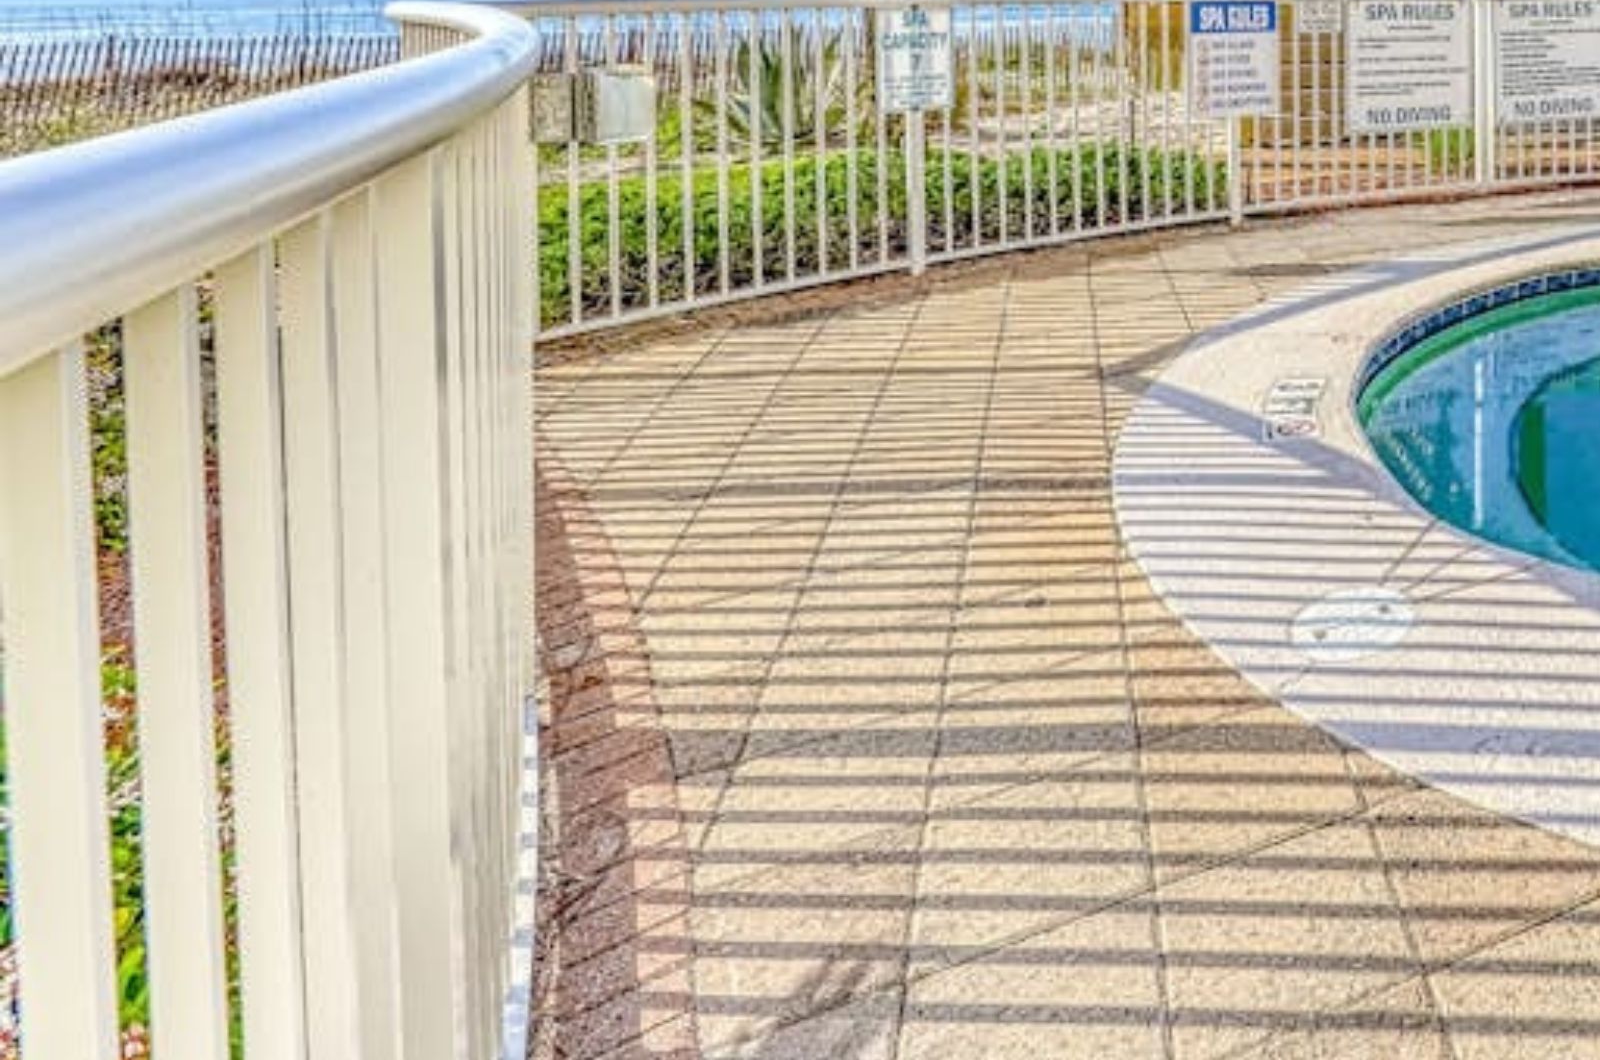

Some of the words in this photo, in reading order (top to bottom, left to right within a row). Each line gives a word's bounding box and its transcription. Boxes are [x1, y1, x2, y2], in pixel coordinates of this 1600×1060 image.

[1199, 5, 1226, 32] SPA
[1228, 3, 1270, 30] RULES
[1363, 3, 1398, 21] SPA
[1402, 3, 1456, 21] RULES
[1508, 2, 1539, 19] SPA
[1543, 0, 1595, 18] RULES
[882, 31, 949, 50] CAPACITY
[1366, 107, 1392, 124] NO
[1396, 103, 1451, 124] DIVING
[1513, 100, 1536, 117] NO
[1540, 97, 1593, 116] DIVING
